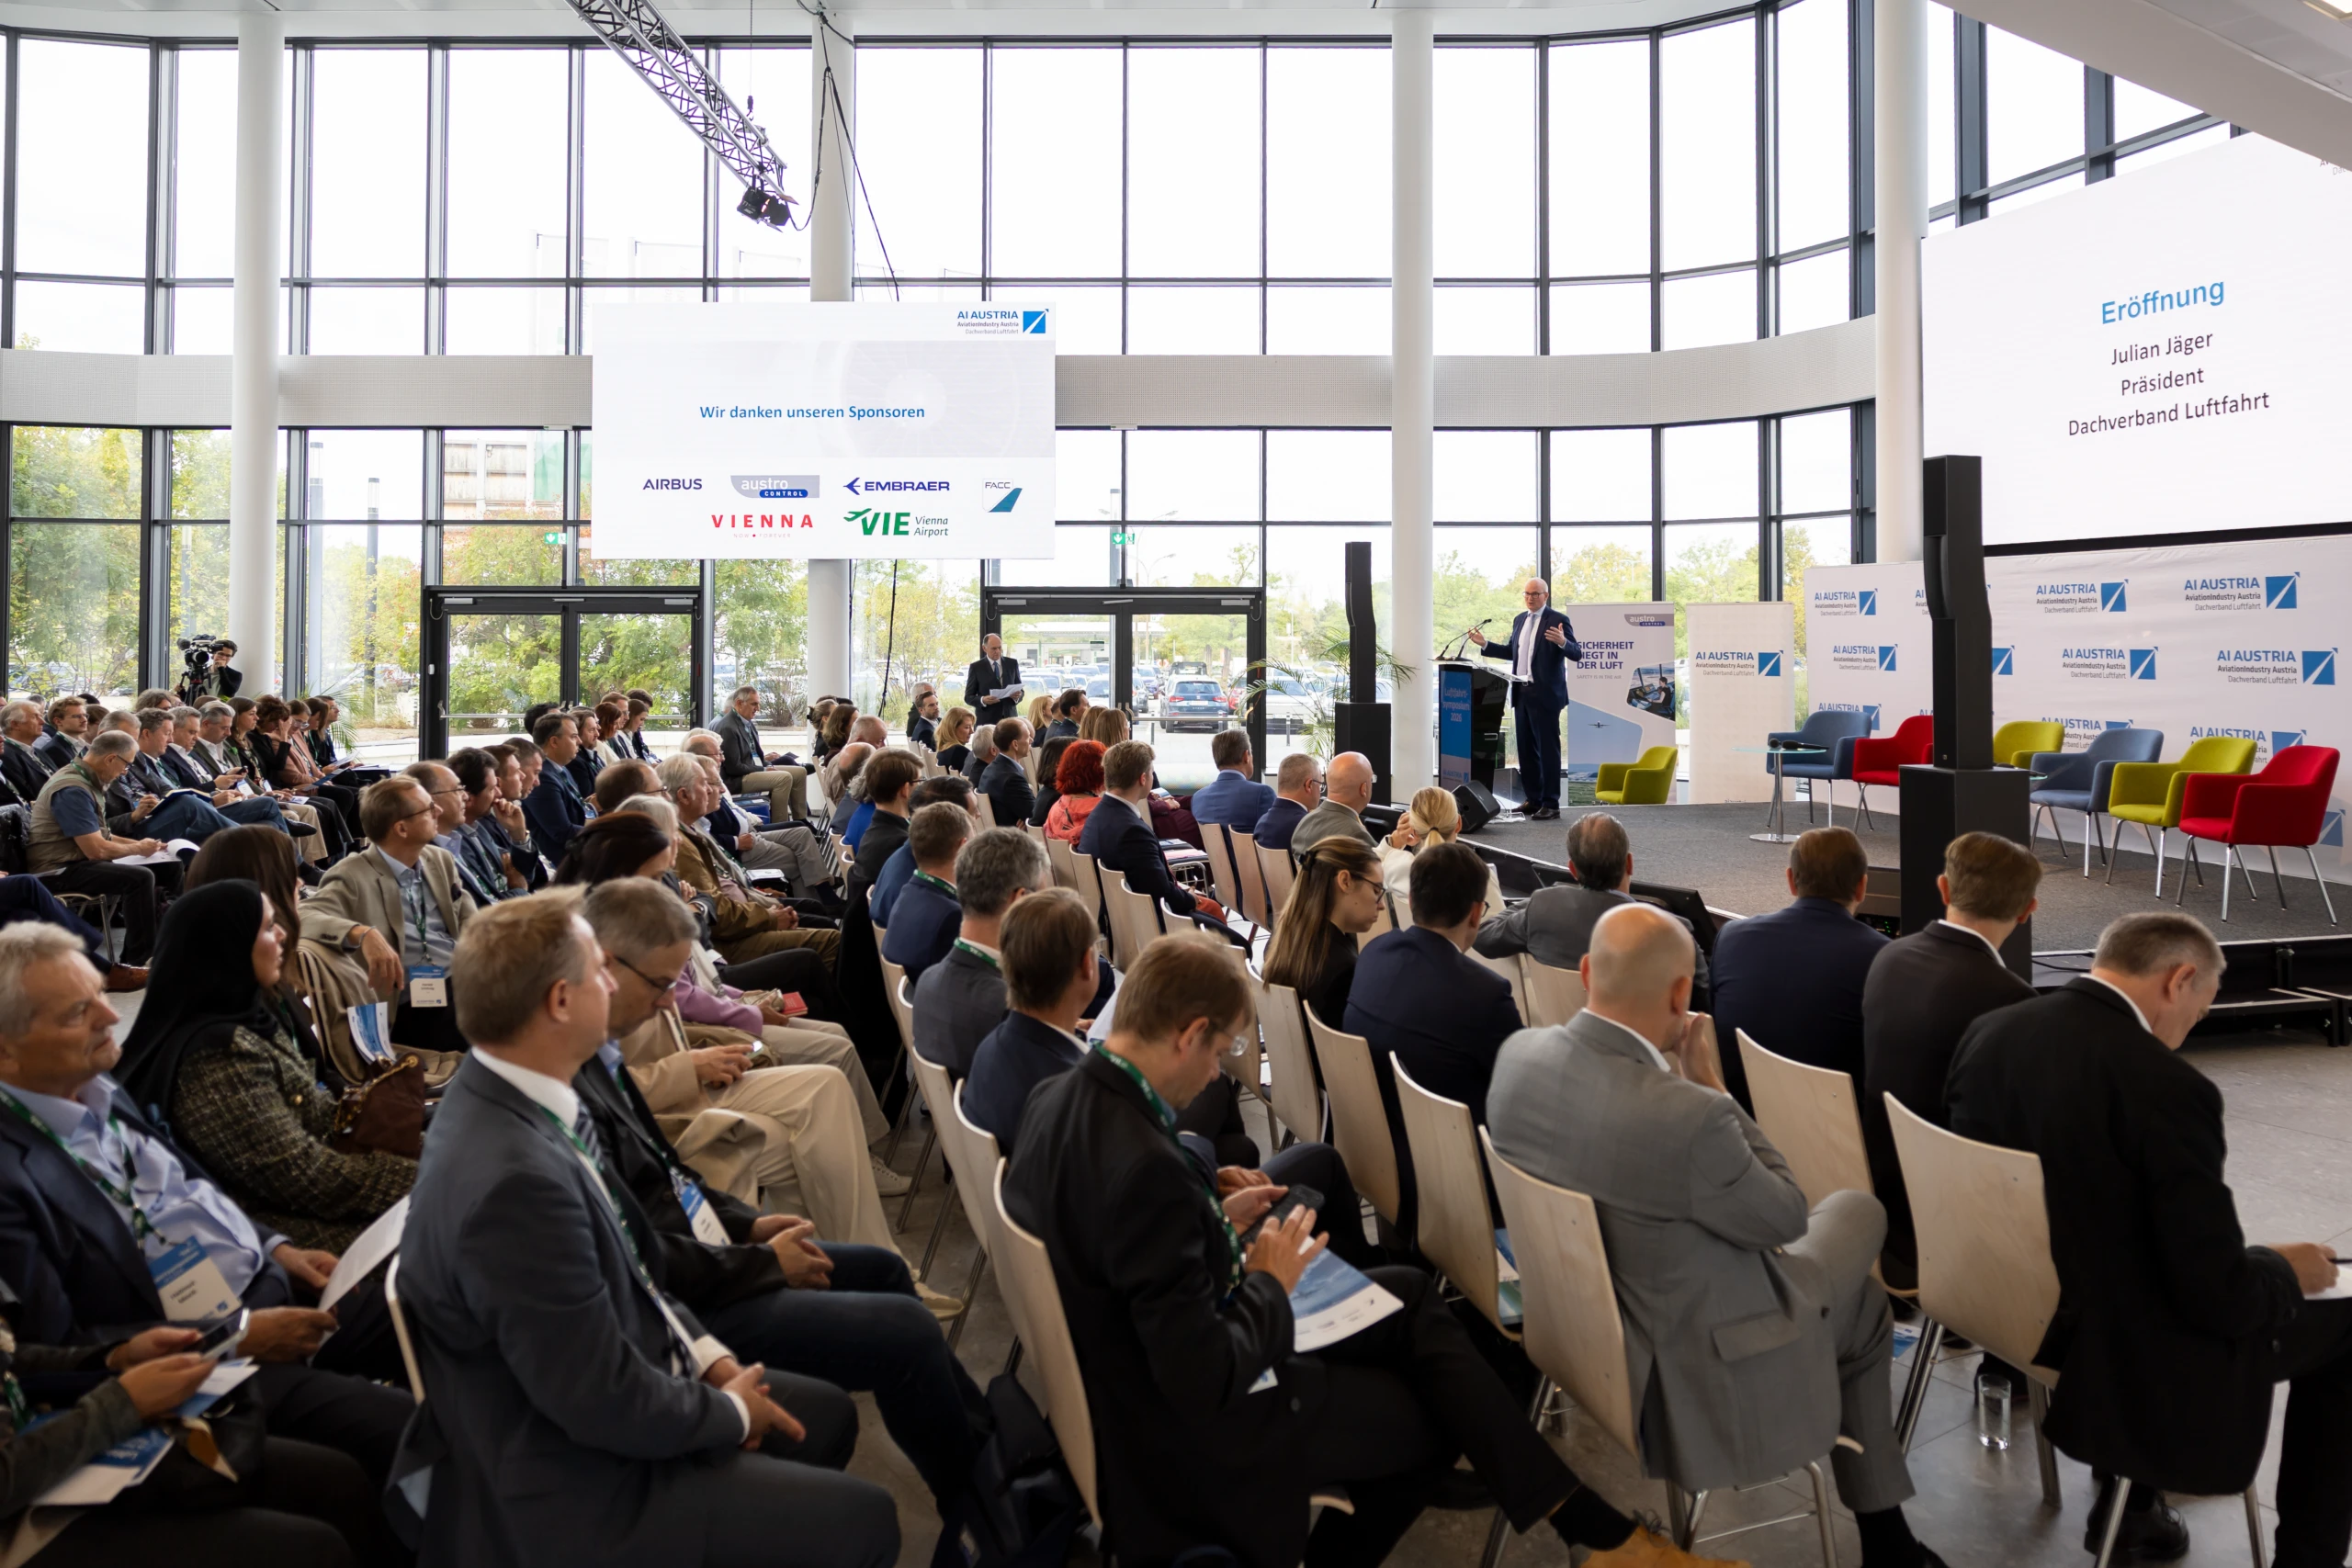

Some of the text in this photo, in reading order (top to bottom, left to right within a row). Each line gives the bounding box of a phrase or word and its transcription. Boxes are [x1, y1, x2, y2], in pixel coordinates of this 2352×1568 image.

[2101, 281, 2225, 325] Eröffnung
[957, 310, 1019, 320] AI AUSTRIA
[2111, 331, 2213, 367] Julian Jäger
[2120, 367, 2205, 396] Präsident
[699, 405, 925, 422] Wir danken unseren Sponsoren
[2068, 391, 2270, 436] Dachverband Luftfahrt
[642, 479, 703, 491] AIRBUS
[741, 478, 788, 491] austro
[865, 481, 950, 491] EMBRAER
[711, 514, 814, 528] VIENNA
[861, 512, 910, 536] VIE
[915, 515, 948, 525] Vienna
[913, 527, 949, 537] Airport
[2036, 583, 2097, 595] AI AUSTRIA
[2184, 577, 2260, 591] AI AUSTRIA
[1815, 591, 1856, 601] AI AUSTRIA
[1916, 589, 1924, 598] AI
[2185, 593, 2236, 602] AviationIndustry
[2195, 603, 2233, 611] Dachverband
[1629, 615, 1656, 623] austro
[1577, 641, 1634, 649] SICHERHEIT
[1833, 645, 1876, 654] AI AUSTRIA
[1581, 651, 1618, 660] IEGT IN
[1695, 651, 1755, 660] AI AUSTRIA
[2062, 649, 2126, 660] AI AUSTRIA
[2217, 650, 2297, 662] AI AUSTRIA
[1577, 661, 1623, 670] DER LUFT
[2063, 661, 2105, 671] AviationIndustry
[2217, 665, 2297, 674] AviationIndustry Austria
[2071, 671, 2127, 680] Dachverband Luftfahrt
[2228, 675, 2298, 684] Dachverband Luftfahrt
[1827, 703, 1860, 712] AUSTRIA
[2190, 727, 2267, 741] AI AUSTRIA
